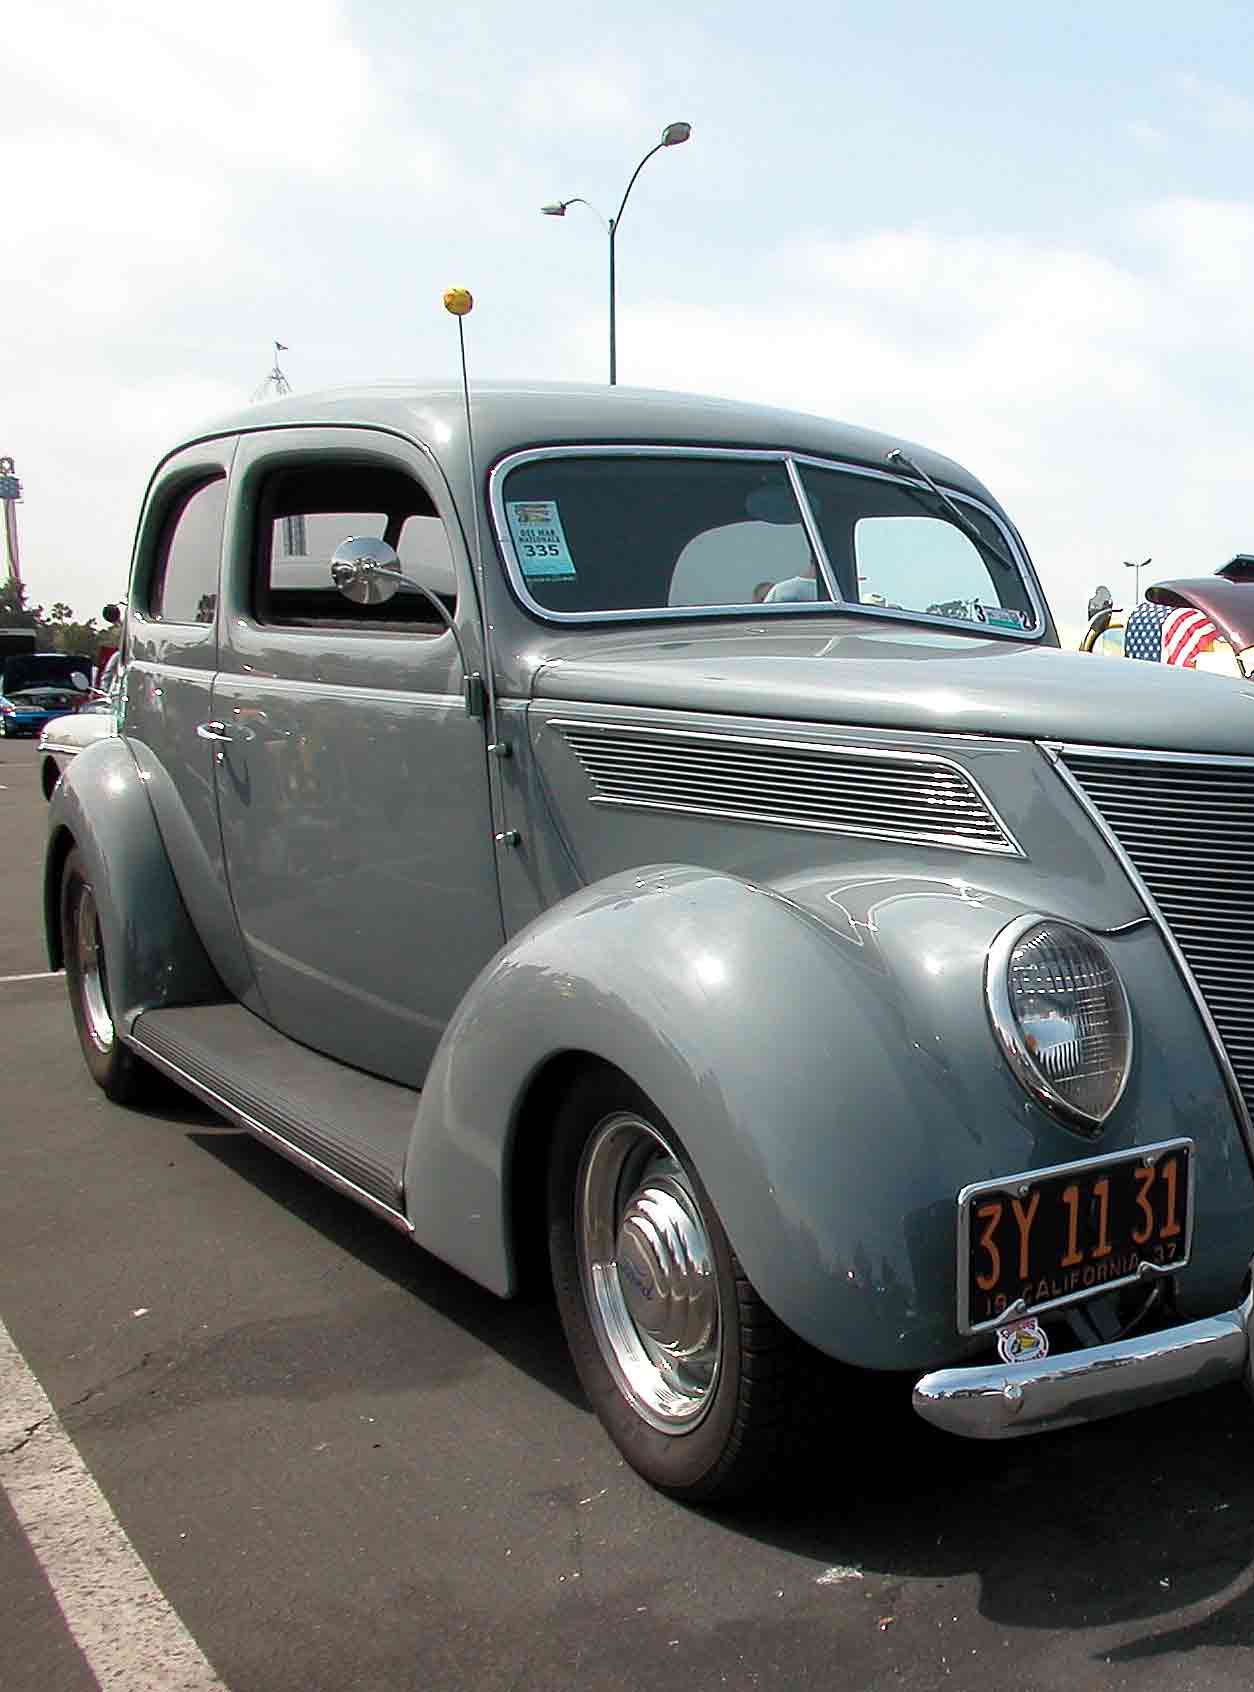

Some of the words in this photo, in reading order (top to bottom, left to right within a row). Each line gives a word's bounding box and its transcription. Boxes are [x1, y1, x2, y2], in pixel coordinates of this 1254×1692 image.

[523, 544, 560, 557] 335
[976, 1189, 1040, 1291] 3Y
[1061, 1177, 1113, 1267] 11
[1132, 1158, 1181, 1245] 31
[1022, 1253, 1140, 1303] CALIFORNIA
